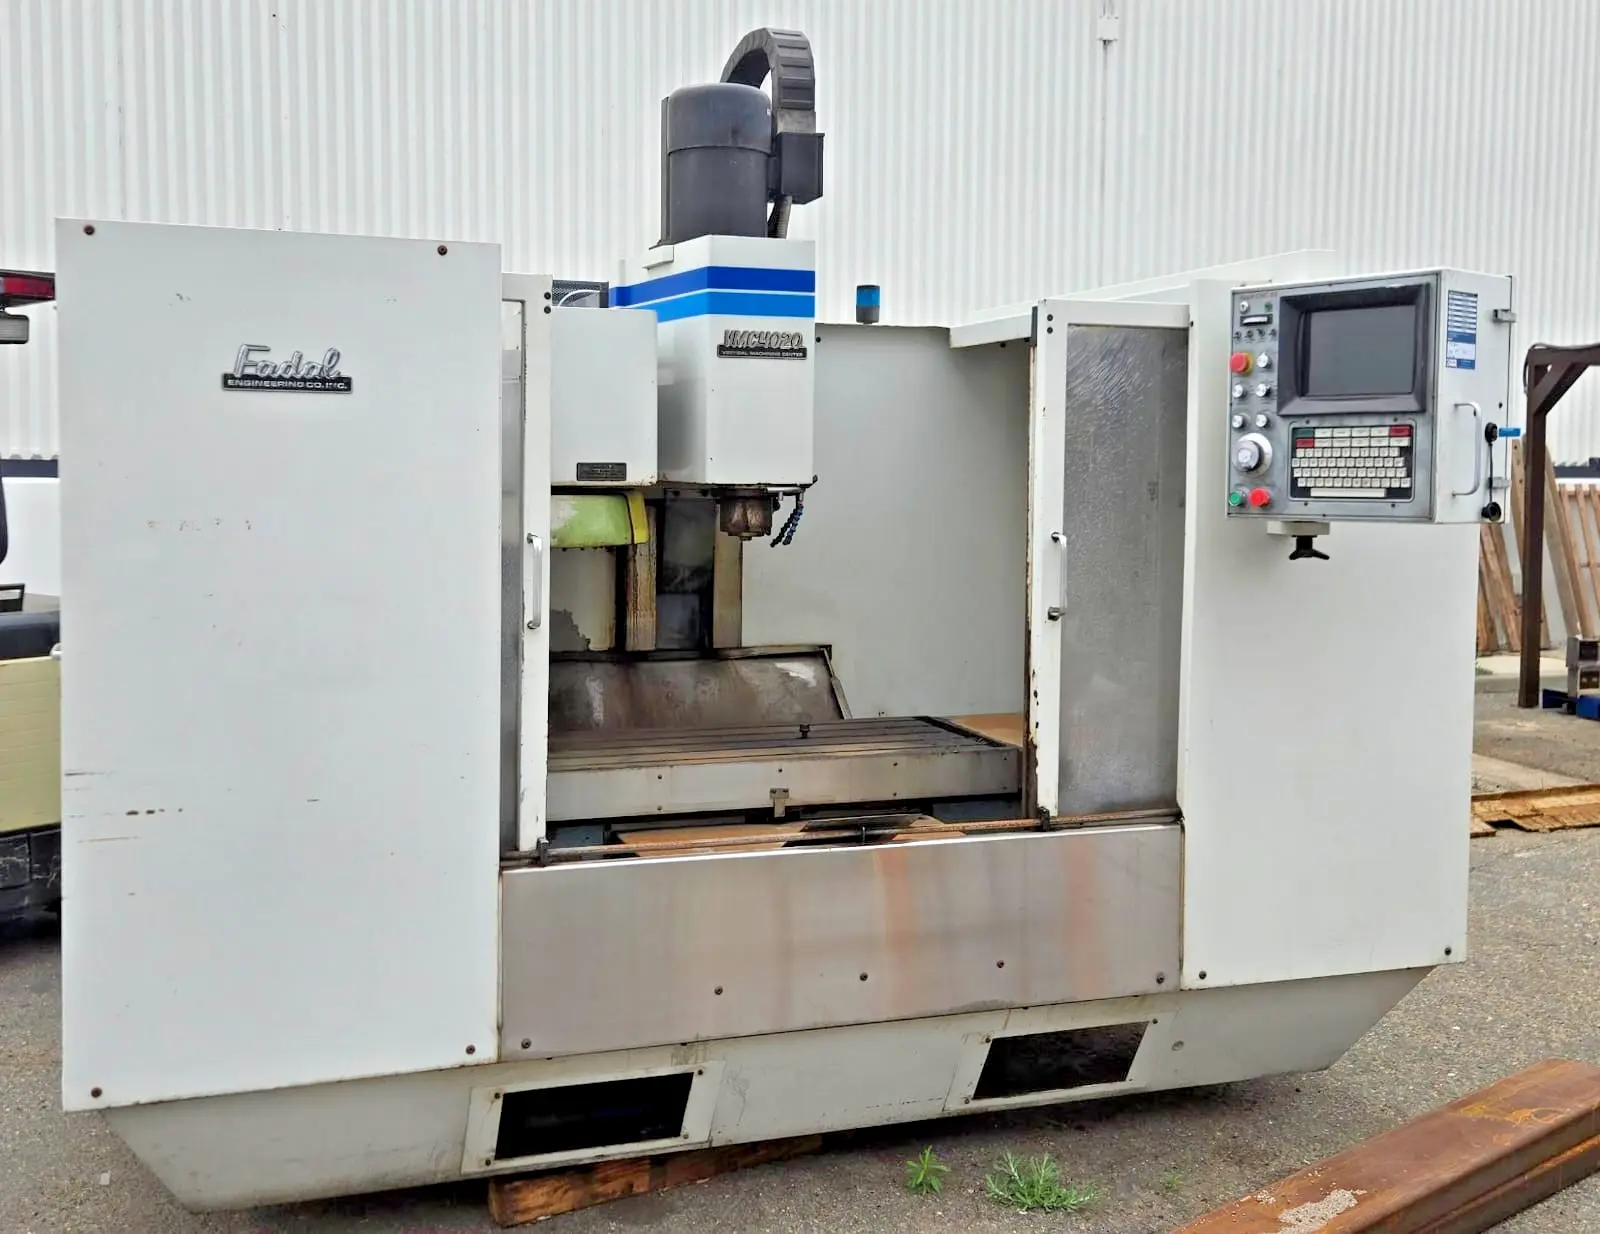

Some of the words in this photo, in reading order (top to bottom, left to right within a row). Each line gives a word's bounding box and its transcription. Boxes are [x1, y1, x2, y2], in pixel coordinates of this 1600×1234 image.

[724, 330, 803, 349] VMC4020
[233, 343, 342, 379] Fadal
[227, 379, 304, 388] ENGINEERING
